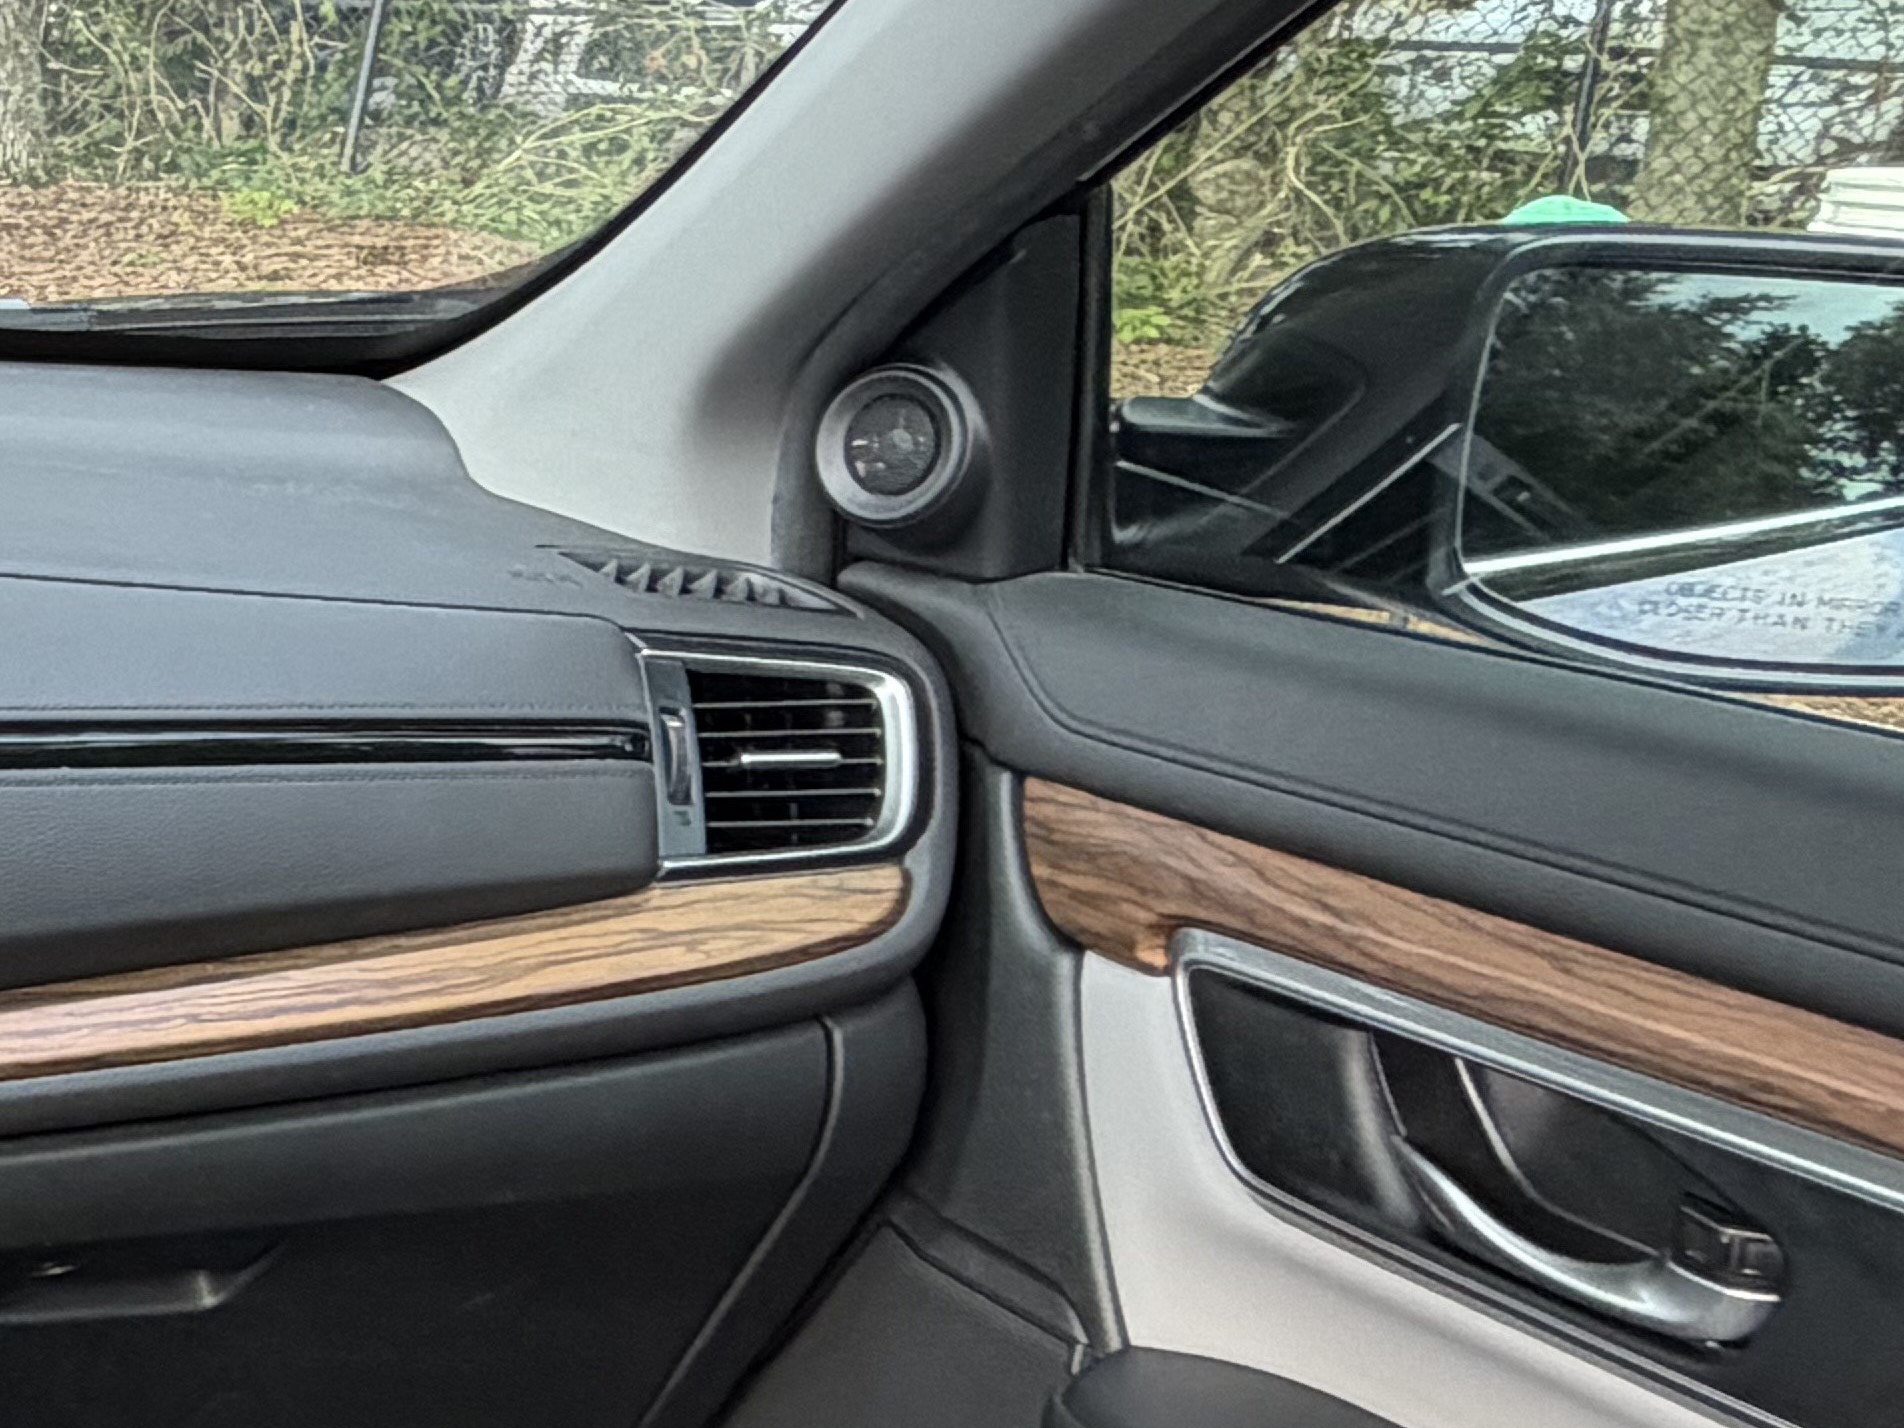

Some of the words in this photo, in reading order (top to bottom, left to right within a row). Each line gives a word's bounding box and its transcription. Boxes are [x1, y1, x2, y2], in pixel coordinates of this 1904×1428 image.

[1665, 581, 1767, 603] OBJECTS
[1778, 590, 1808, 608] IN
[1637, 599, 1726, 621] CLOSER
[1737, 608, 1810, 630] THAN
